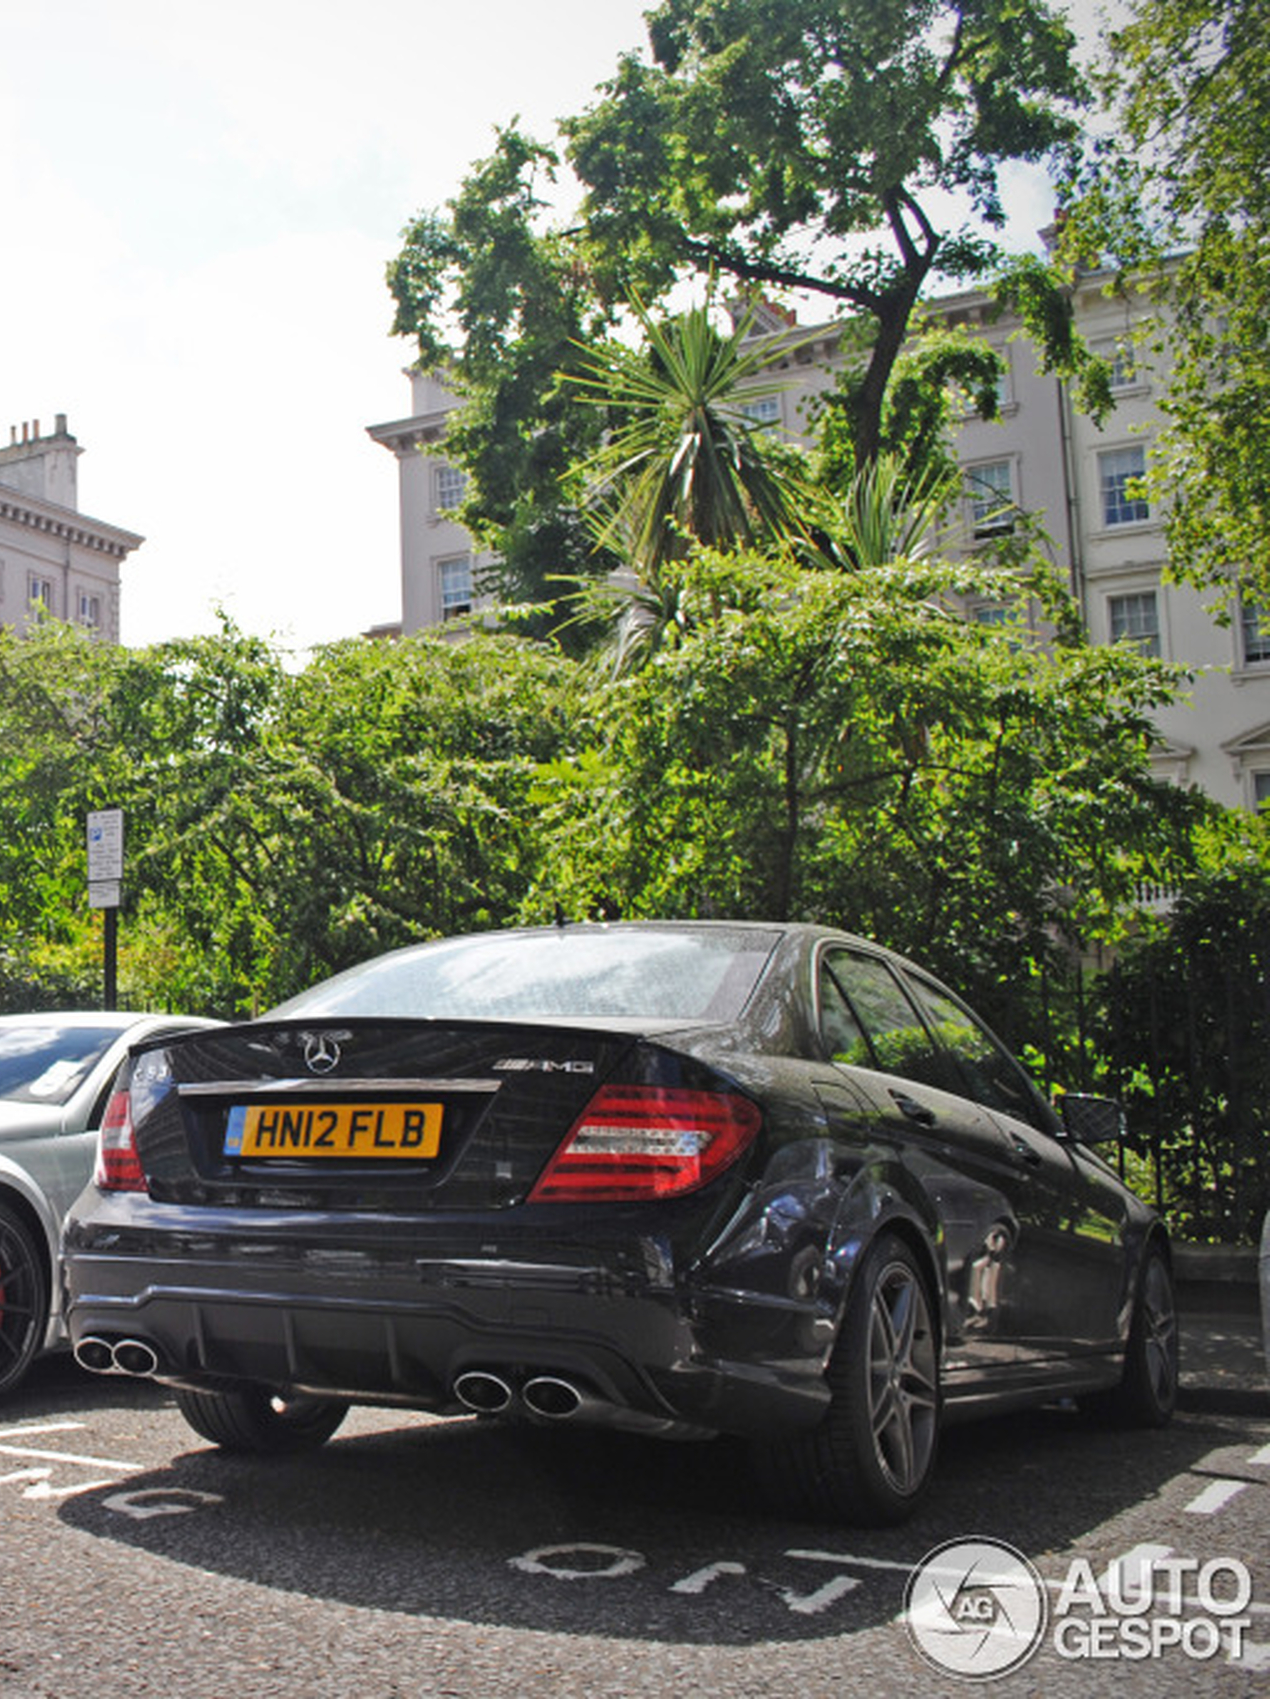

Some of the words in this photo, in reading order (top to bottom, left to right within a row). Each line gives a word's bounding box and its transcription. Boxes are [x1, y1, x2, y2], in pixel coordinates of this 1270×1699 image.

[532, 1060, 594, 1073] AMG
[255, 1110, 338, 1147] HN12
[348, 1110, 426, 1148] FLB
